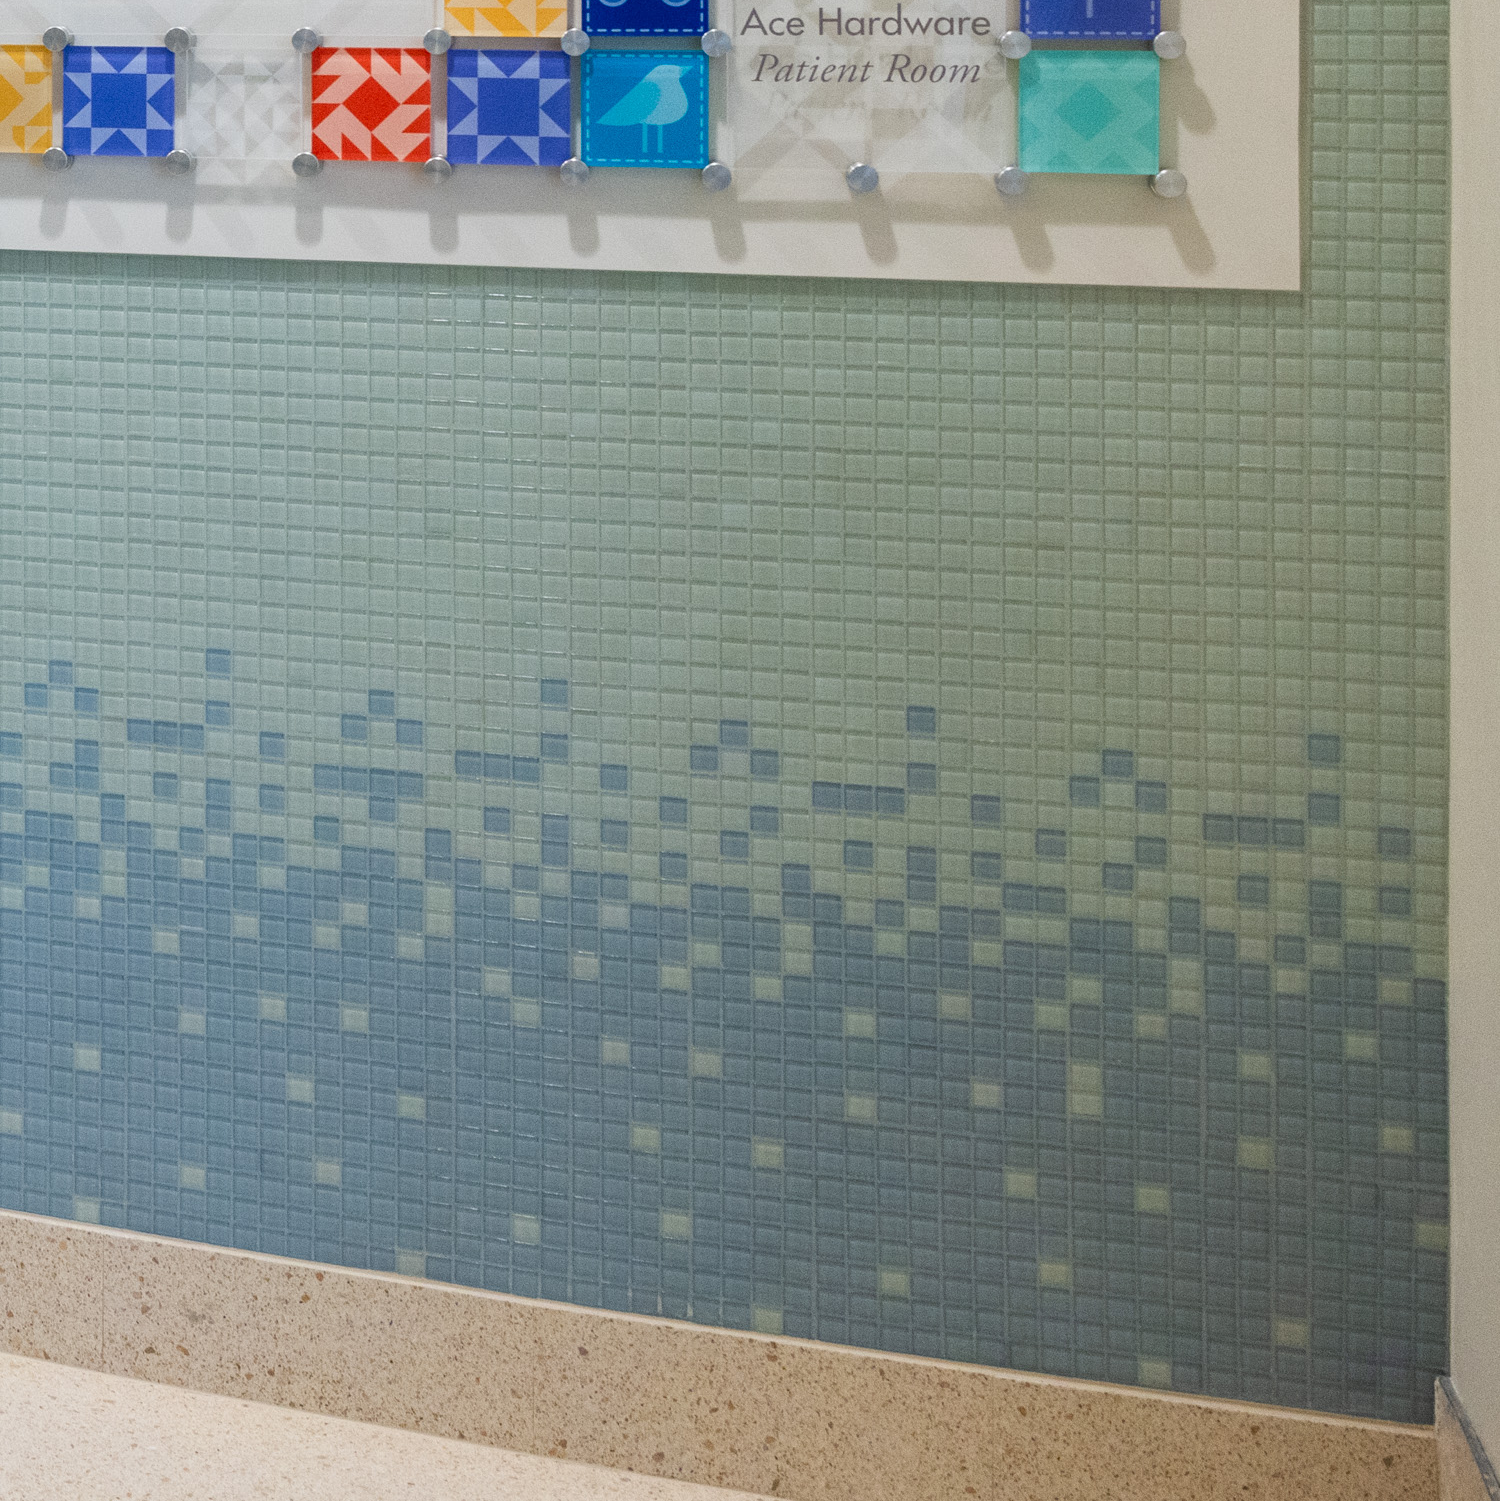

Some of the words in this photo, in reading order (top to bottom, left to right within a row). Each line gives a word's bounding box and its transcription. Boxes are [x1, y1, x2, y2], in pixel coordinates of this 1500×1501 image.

[739, 7, 805, 38] Ace
[818, 3, 992, 38] Hardware
[751, 53, 874, 84] Patient
[884, 52, 982, 84] Room
